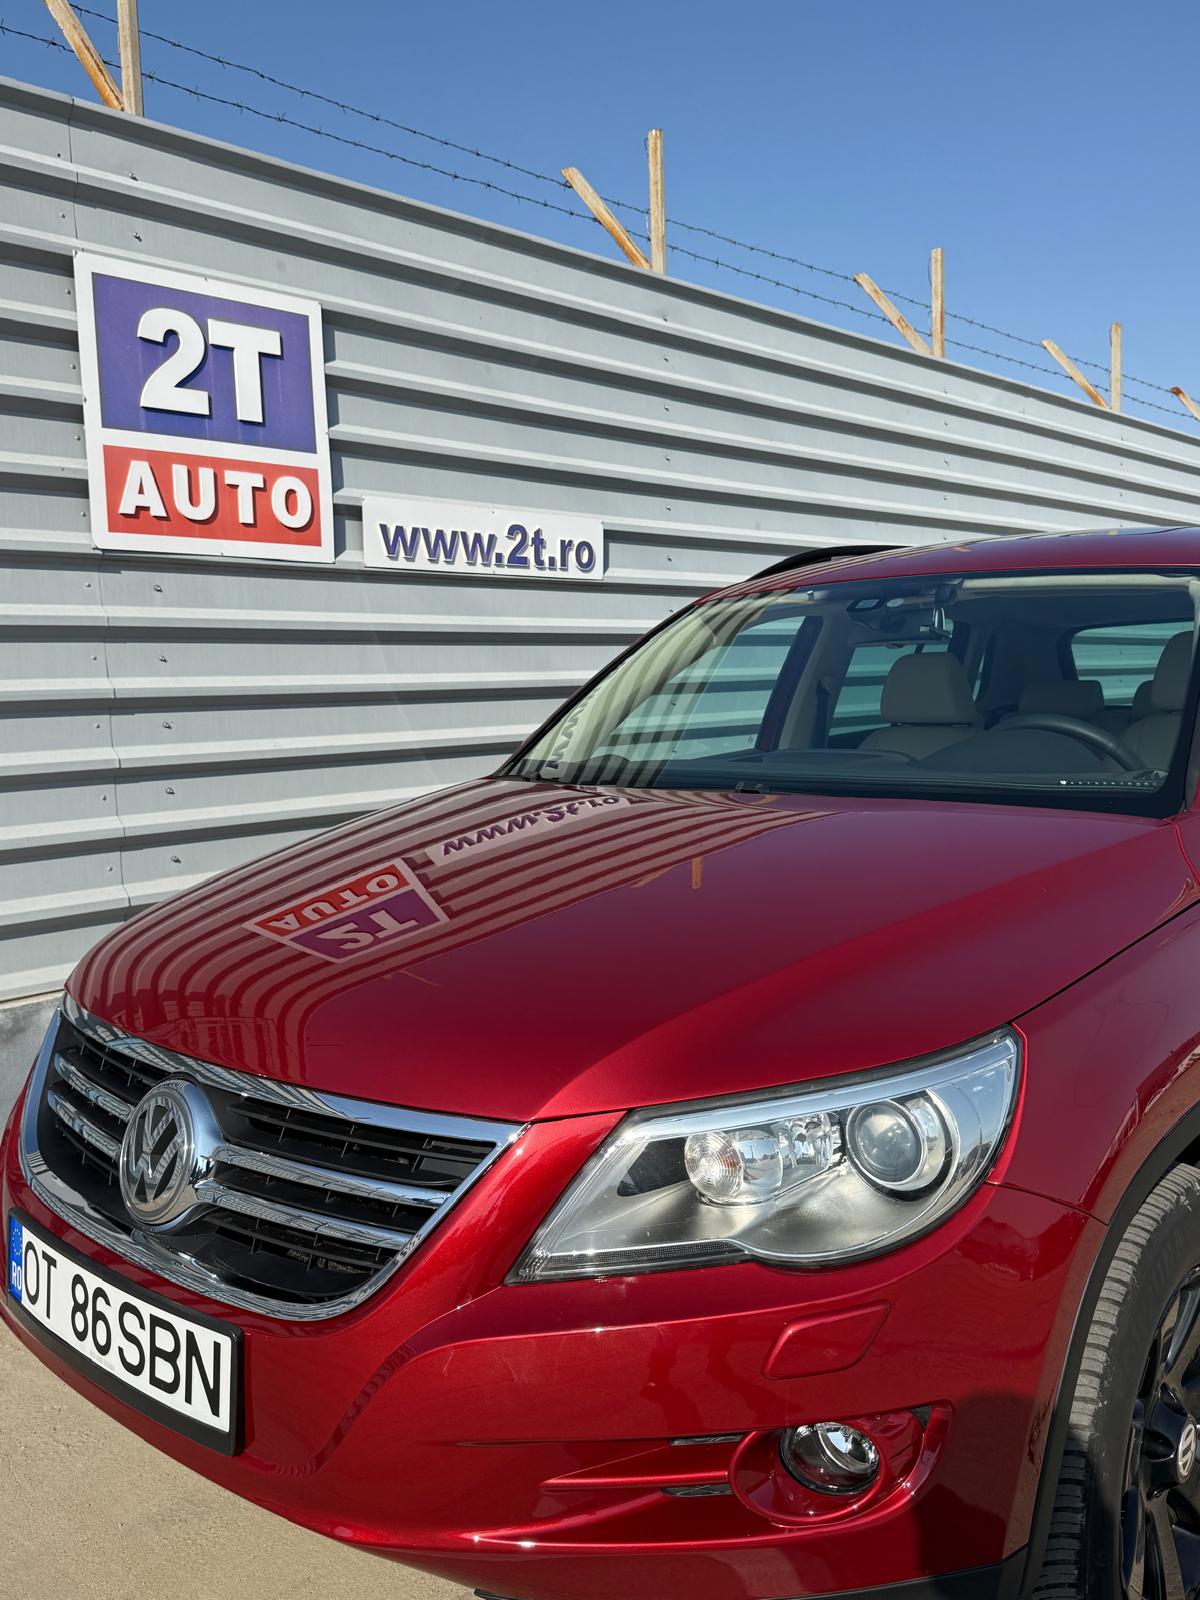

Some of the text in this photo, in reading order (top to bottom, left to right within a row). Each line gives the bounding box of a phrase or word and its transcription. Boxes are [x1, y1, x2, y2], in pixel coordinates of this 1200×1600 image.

[136, 307, 282, 425] 2T
[118, 459, 314, 531] AUTO
[378, 522, 597, 573] www.2t.ro
[11, 1260, 23, 1291] RO
[24, 1240, 58, 1321] OT
